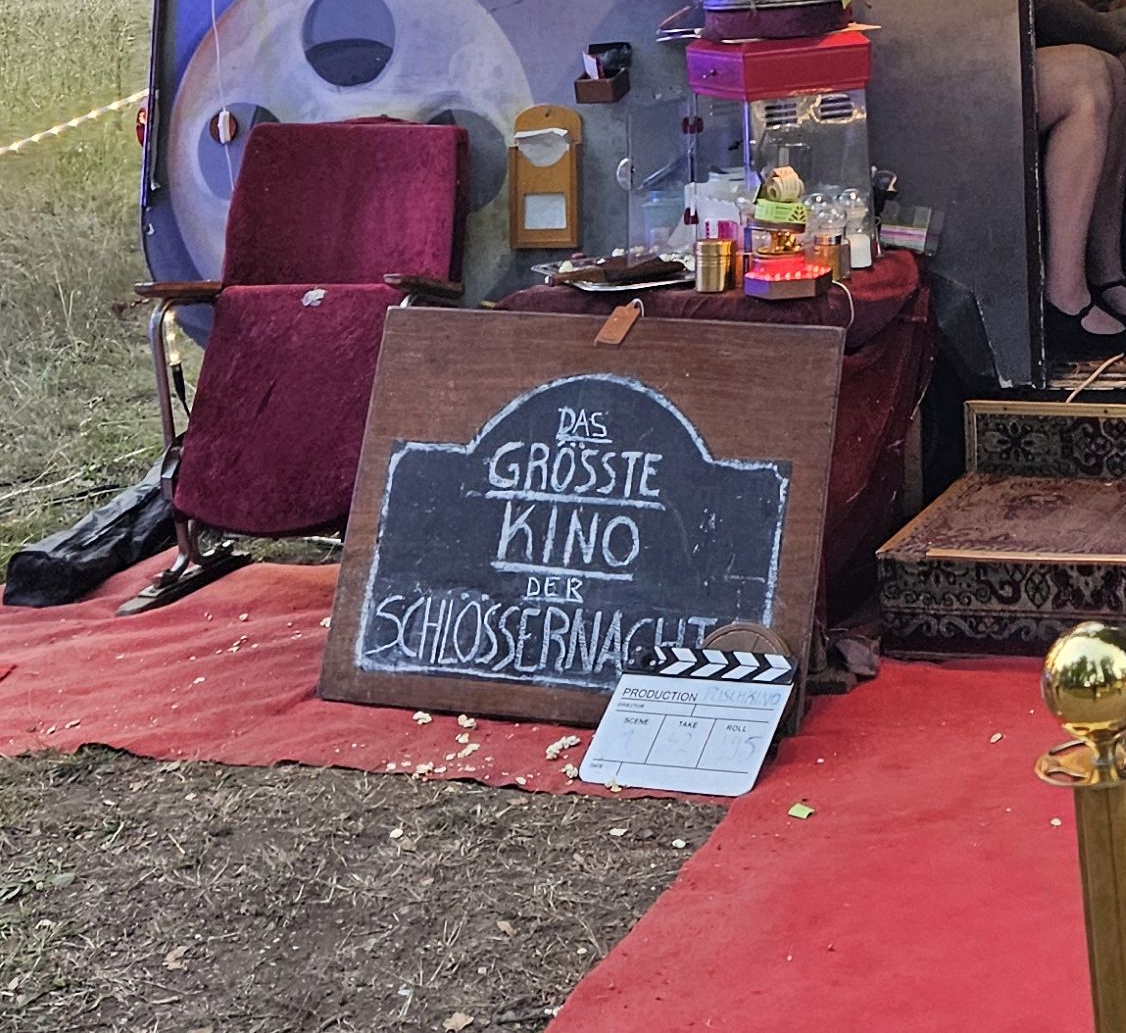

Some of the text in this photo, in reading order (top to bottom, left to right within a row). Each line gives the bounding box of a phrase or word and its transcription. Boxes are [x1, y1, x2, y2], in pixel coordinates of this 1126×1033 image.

[557, 407, 609, 439] DAS
[487, 438, 665, 500] GRÖSSTE
[496, 500, 641, 568] KINO
[526, 576, 583, 598] DER
[621, 687, 698, 702] PRODUCTION
[624, 717, 748, 733] SCENE TAKE ROLL
